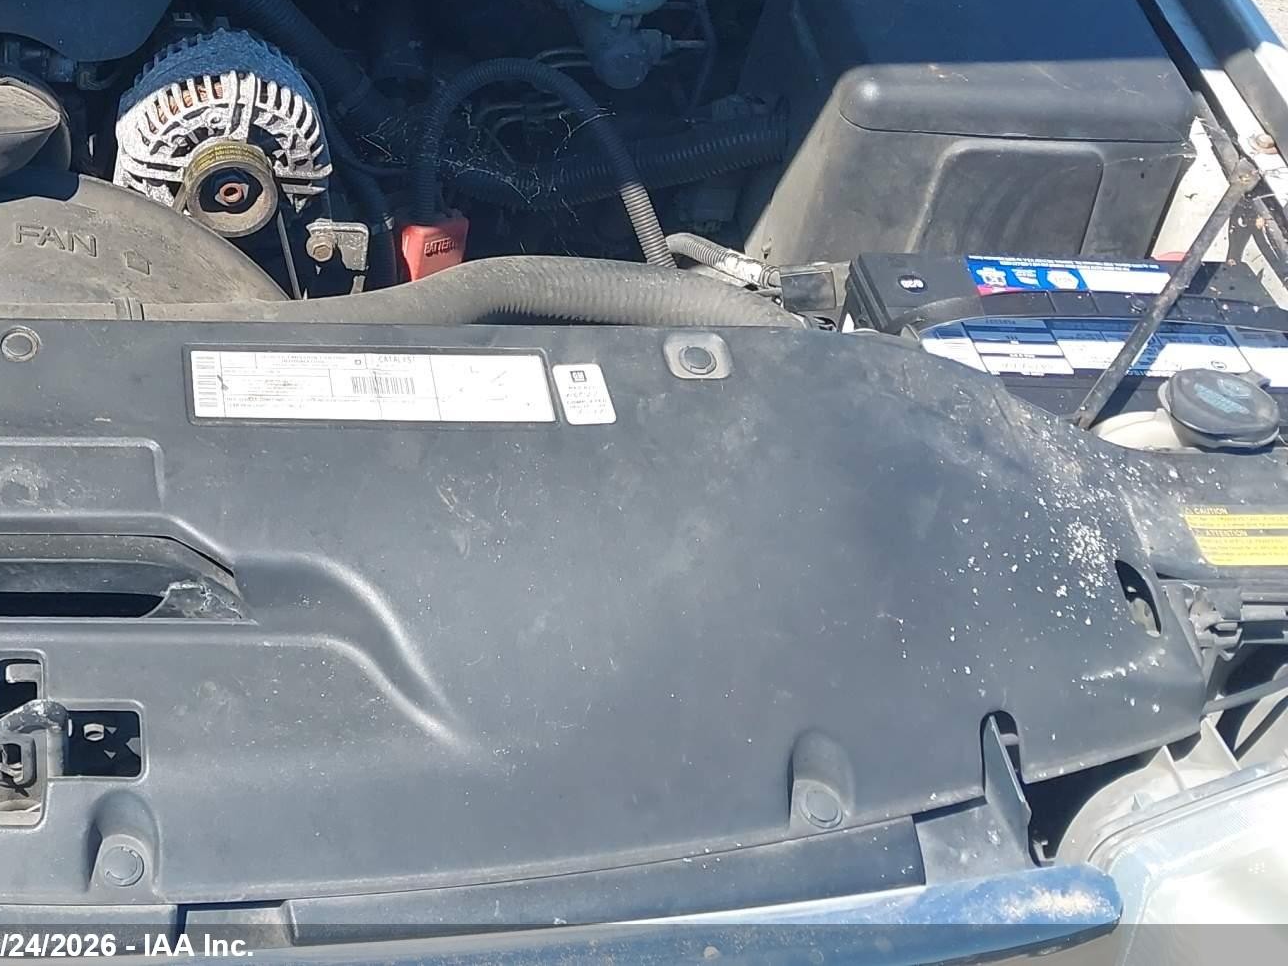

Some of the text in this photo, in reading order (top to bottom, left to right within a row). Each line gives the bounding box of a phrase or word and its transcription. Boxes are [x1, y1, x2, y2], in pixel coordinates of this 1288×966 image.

[14, 223, 98, 258] FAN
[1193, 507, 1228, 515] CAUTION
[1206, 529, 1248, 537] ATTENTION
